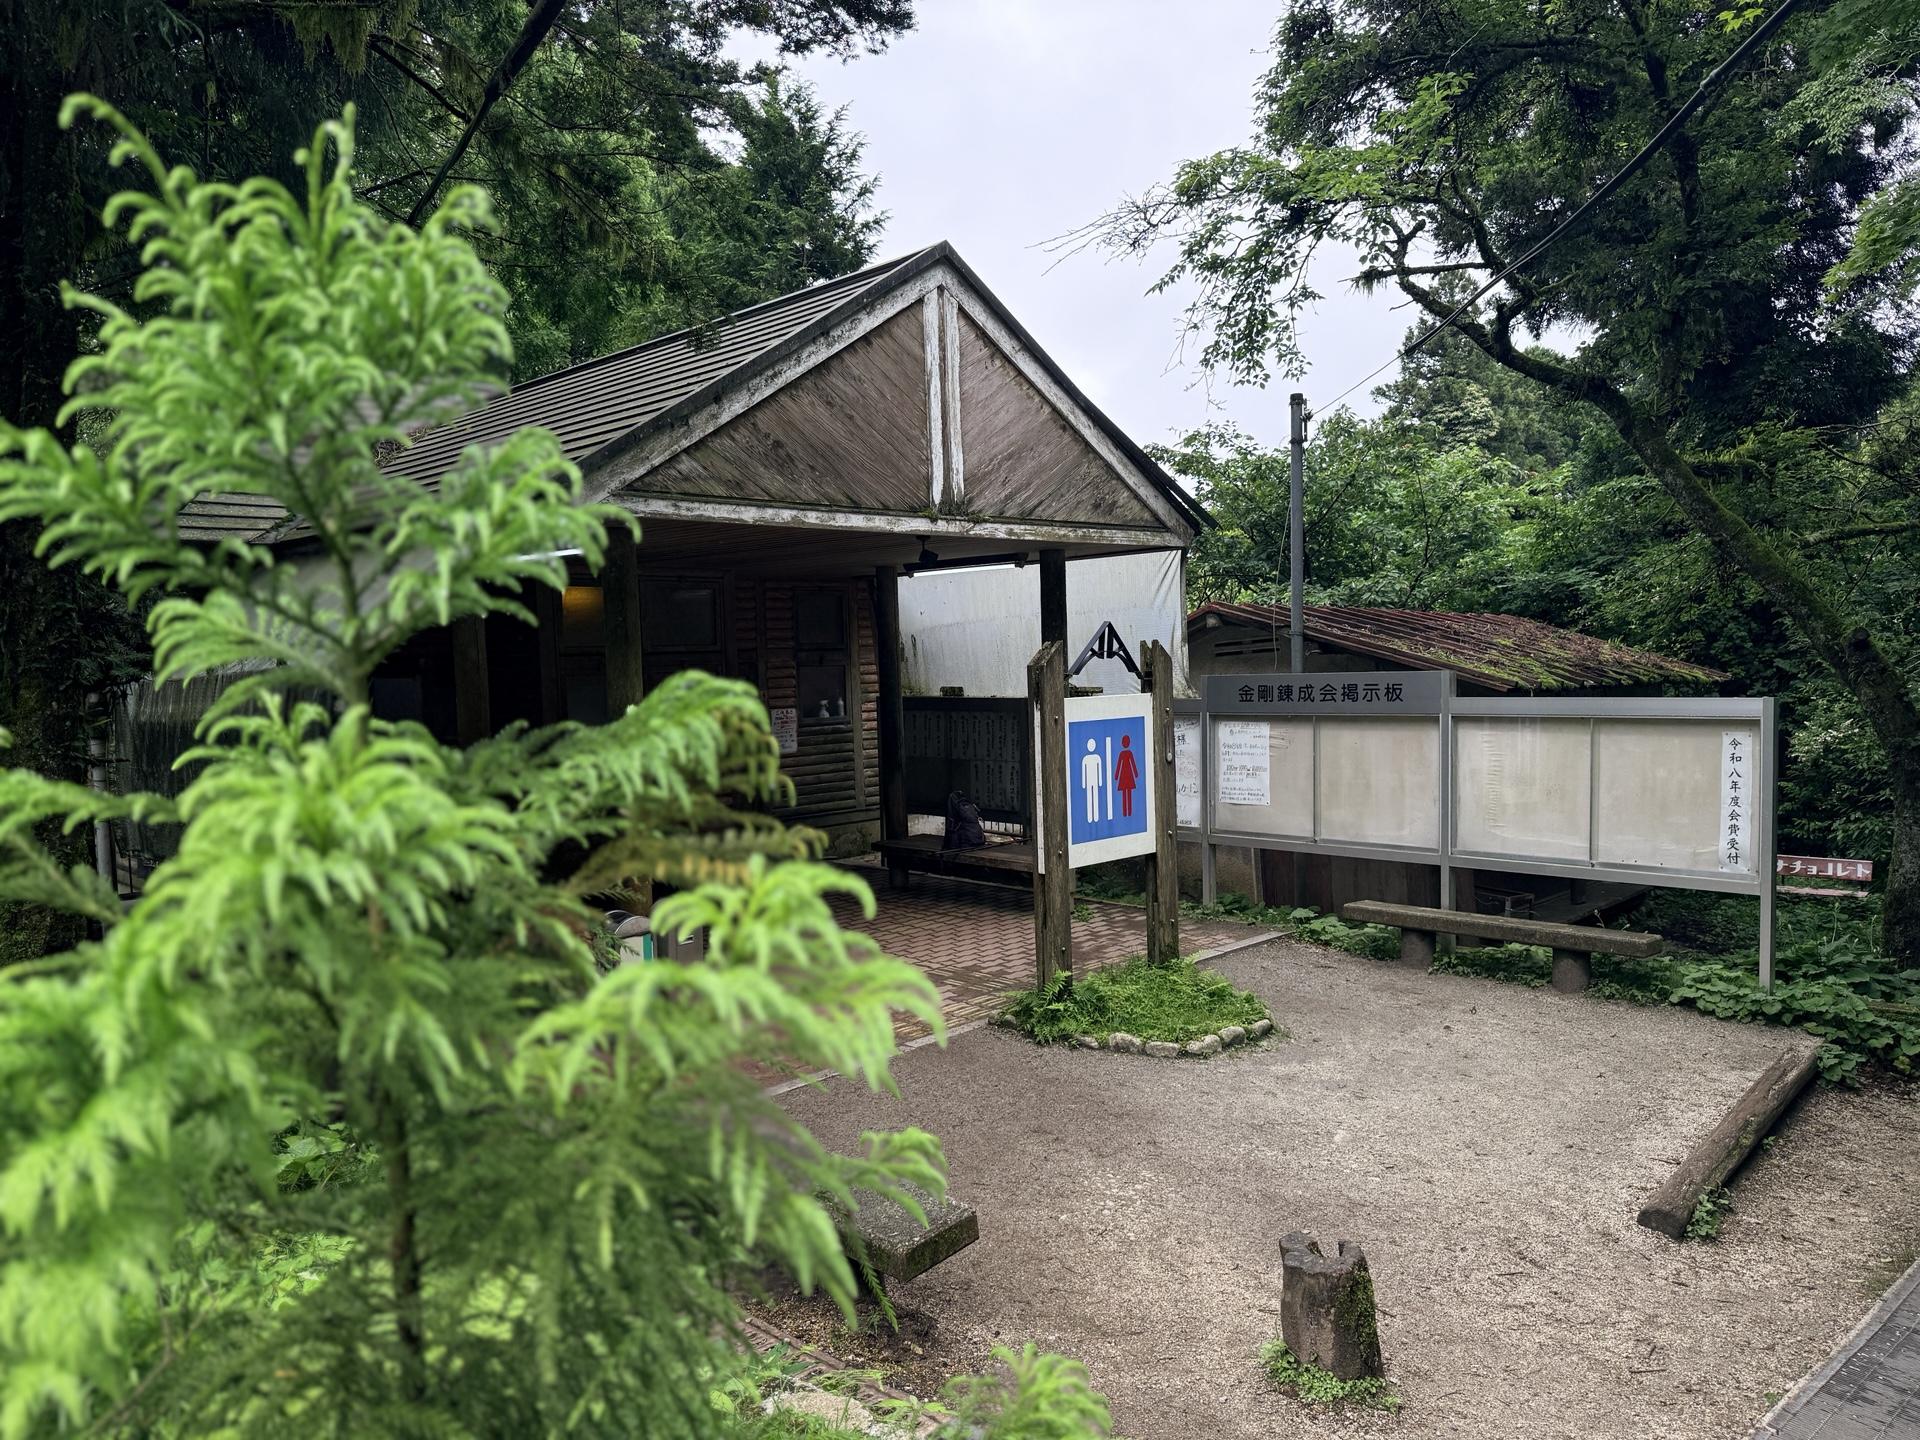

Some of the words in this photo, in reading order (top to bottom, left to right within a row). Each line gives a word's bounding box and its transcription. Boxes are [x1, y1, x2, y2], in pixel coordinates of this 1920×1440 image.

[1238, 683, 1404, 703] 金剛錬成会掲示板
[1727, 737, 1743, 865] 令和八年度会費受付
